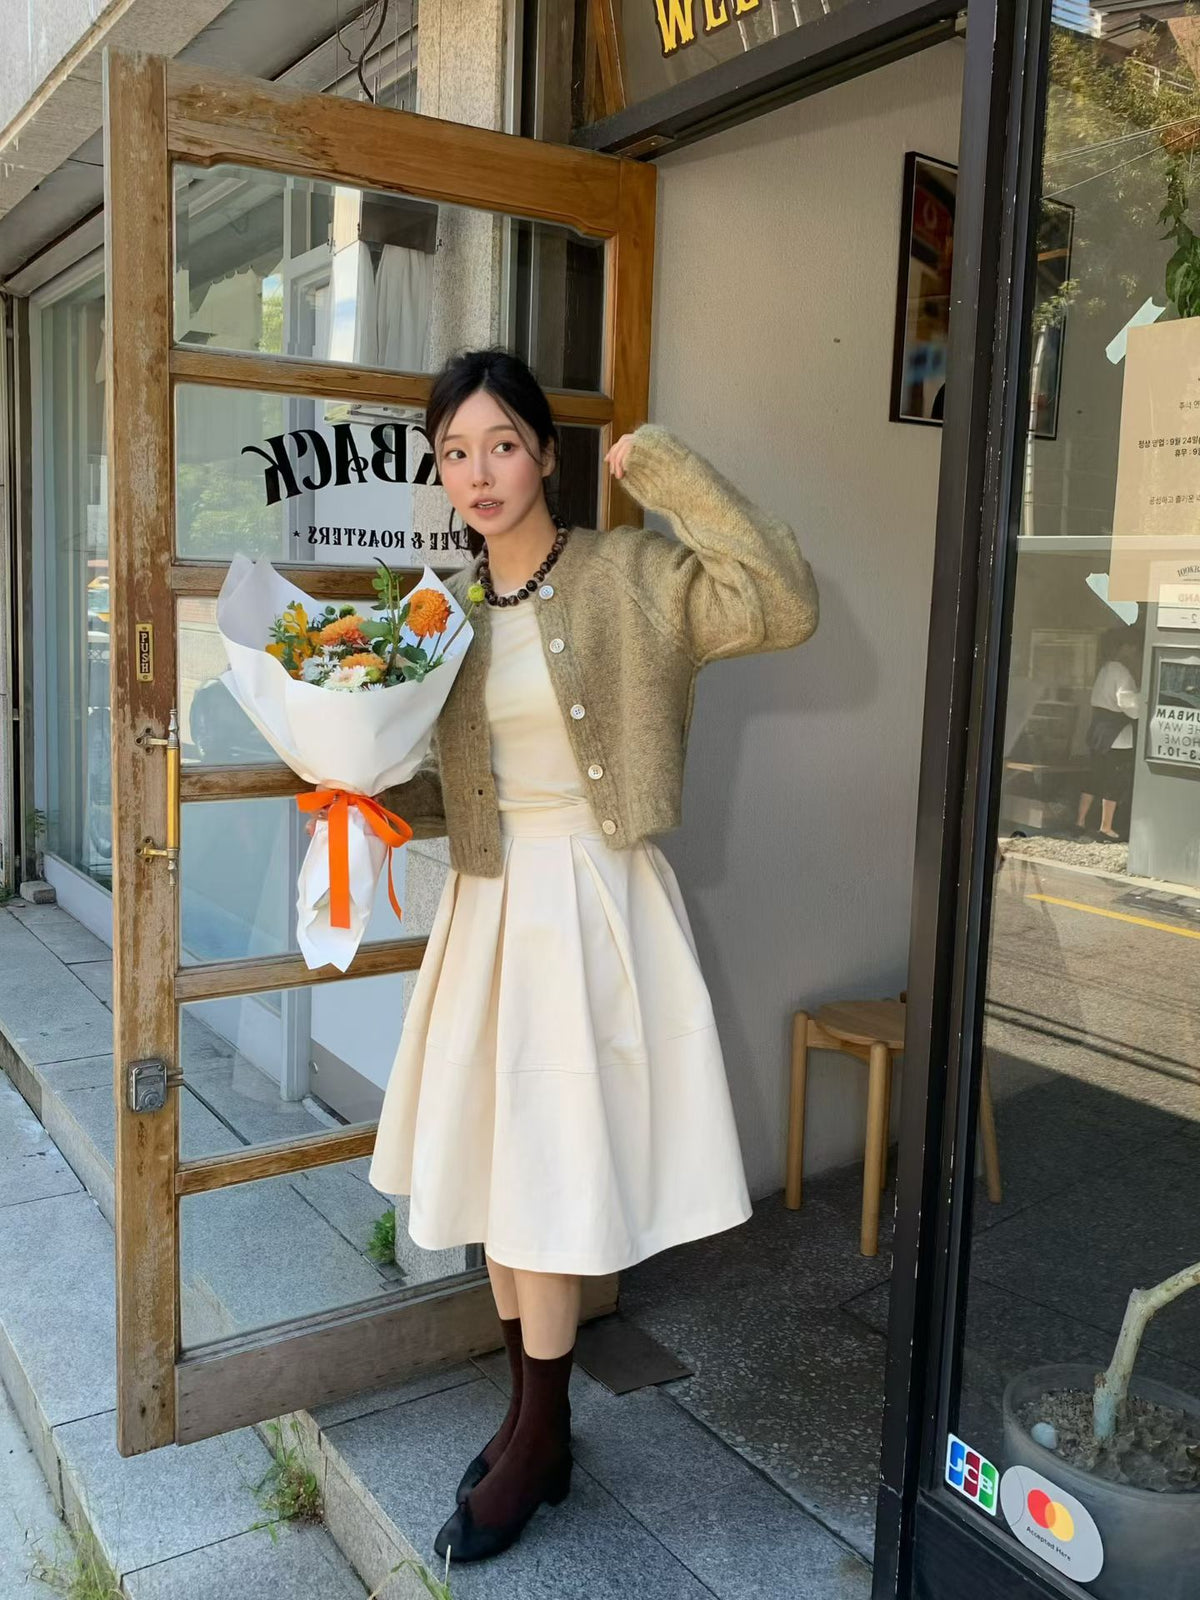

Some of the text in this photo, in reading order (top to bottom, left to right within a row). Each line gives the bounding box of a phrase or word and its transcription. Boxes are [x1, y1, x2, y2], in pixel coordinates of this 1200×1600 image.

[140, 632, 149, 673] PUSH
[949, 1444, 996, 1506] JCB
[1026, 1526, 1071, 1562] Accepted Here
